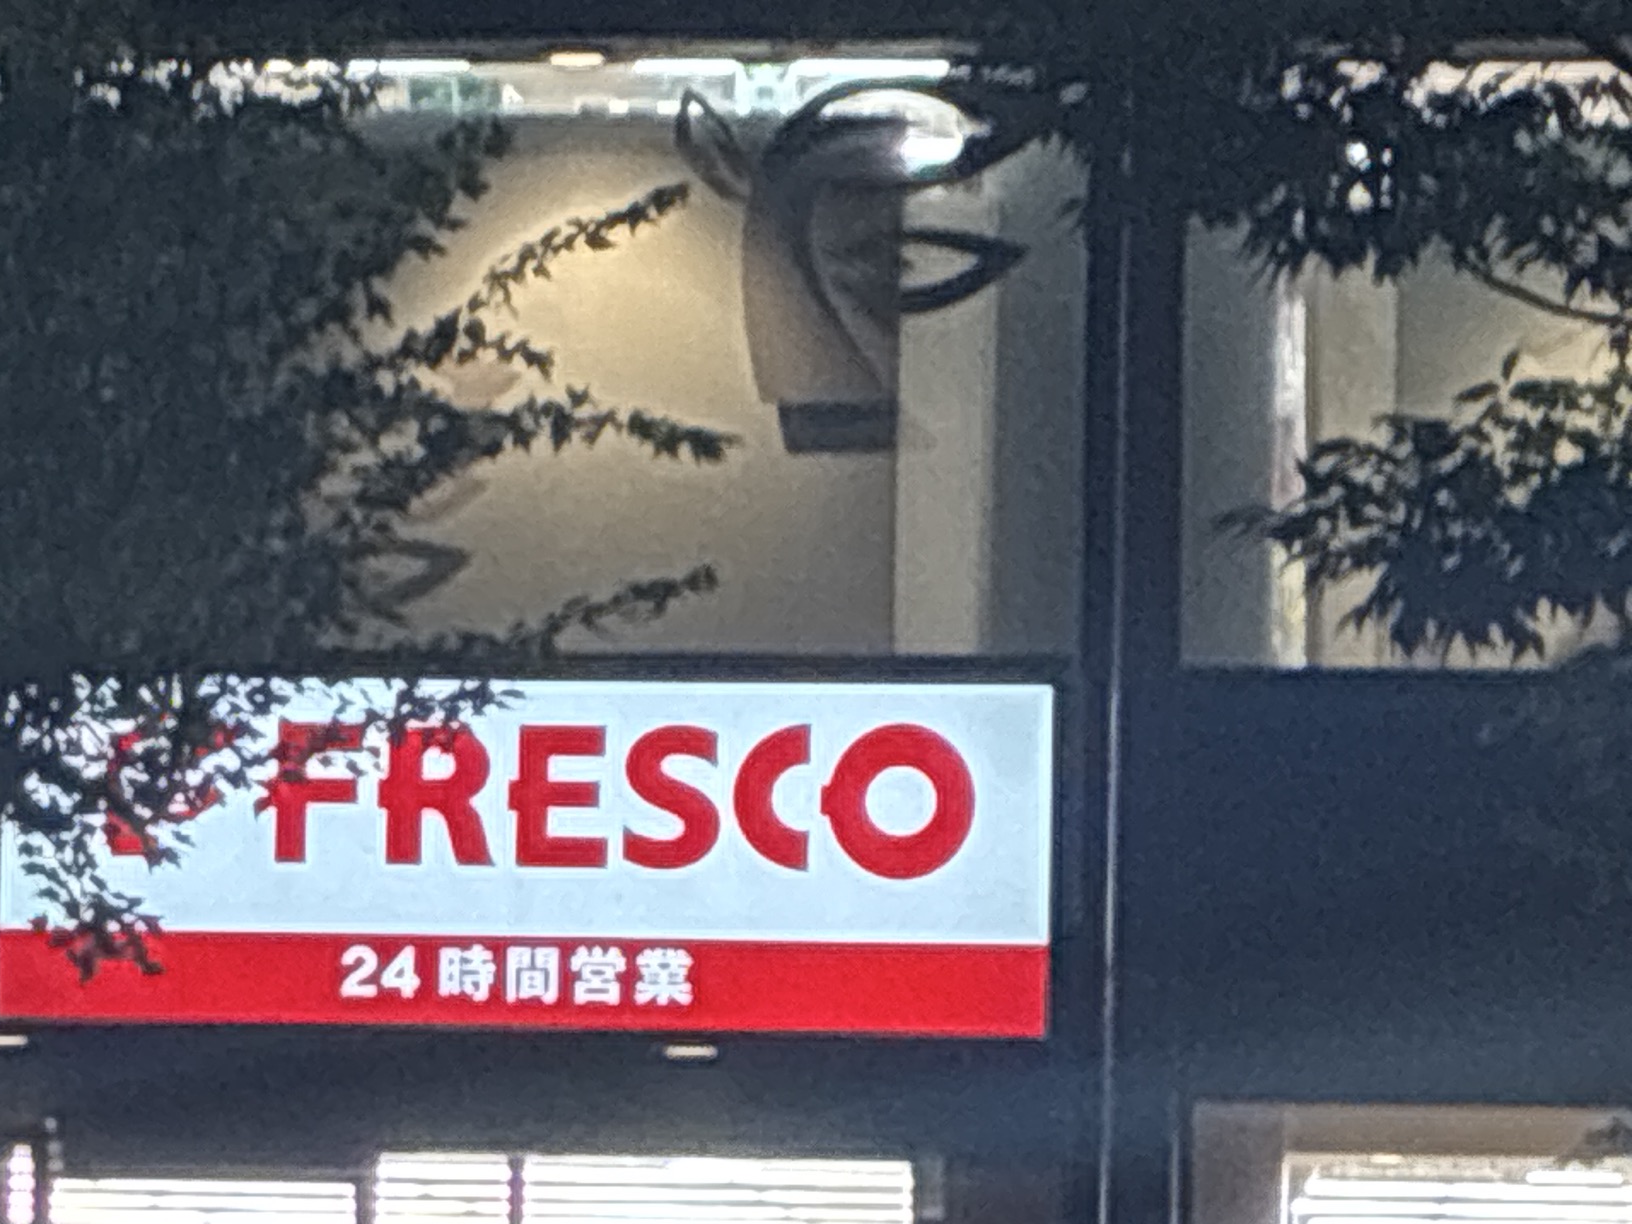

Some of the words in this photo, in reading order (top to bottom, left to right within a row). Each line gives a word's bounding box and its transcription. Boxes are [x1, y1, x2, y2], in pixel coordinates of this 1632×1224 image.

[256, 720, 976, 880] FRESCO
[339, 943, 695, 1007] 24時間営業
